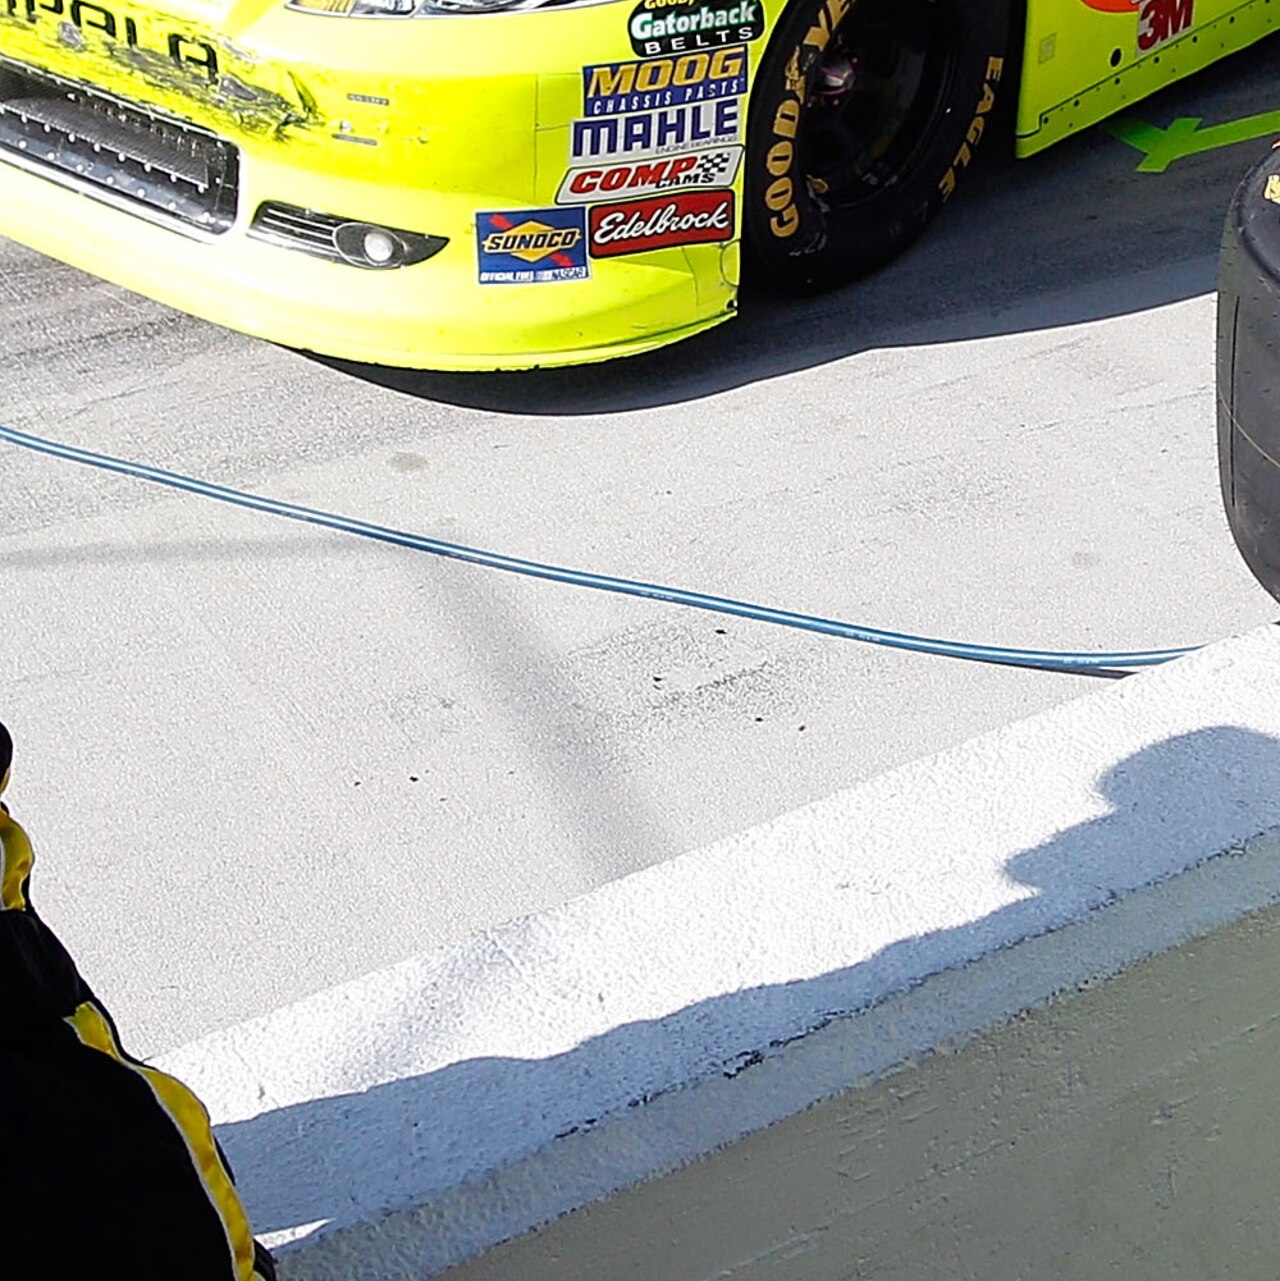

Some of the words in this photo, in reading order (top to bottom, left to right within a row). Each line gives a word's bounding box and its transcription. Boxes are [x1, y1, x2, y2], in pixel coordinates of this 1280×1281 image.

[631, 0, 758, 41] Gatorback
[645, 27, 754, 55] BELTS
[587, 46, 745, 98] MOOG
[593, 91, 673, 115] CHASSIS
[572, 98, 738, 157] MAHLE
[937, 55, 1005, 204] EAGLE
[570, 156, 699, 193] COMP
[655, 173, 717, 189] CAMS
[487, 230, 578, 251] SUNOCO
[593, 201, 730, 244] Edelbrock
